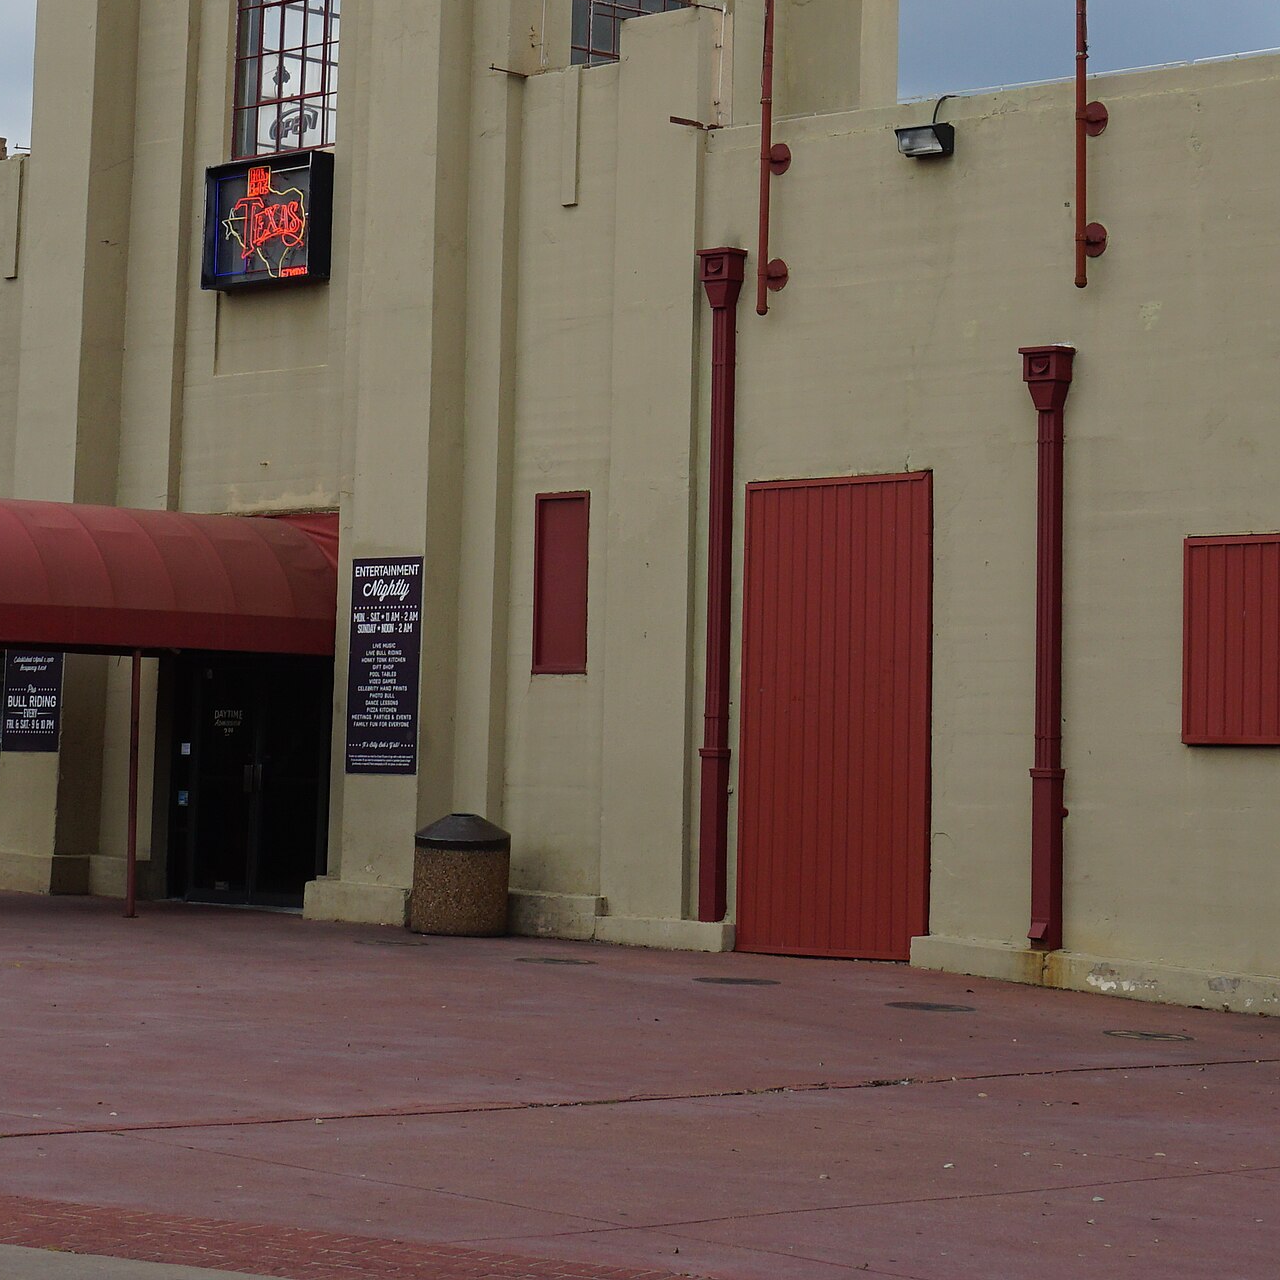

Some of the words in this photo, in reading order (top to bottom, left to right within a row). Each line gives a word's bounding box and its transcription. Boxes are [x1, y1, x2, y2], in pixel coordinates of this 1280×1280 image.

[235, 197, 303, 259] TEXAS
[355, 564, 420, 578] ENTERTAINMENT
[363, 578, 410, 602] Nightly
[391, 612, 400, 622] AM
[404, 611, 408, 621] 2
[409, 611, 419, 621] AM
[357, 623, 377, 633] SUNDAY
[398, 623, 403, 633] 2
[403, 623, 413, 633] AM
[7, 695, 27, 707] BULL
[29, 695, 57, 708] RIDING
[23, 708, 38, 718] EVERY
[214, 709, 243, 720] DAYTIME
[46, 720, 55, 729] PM
